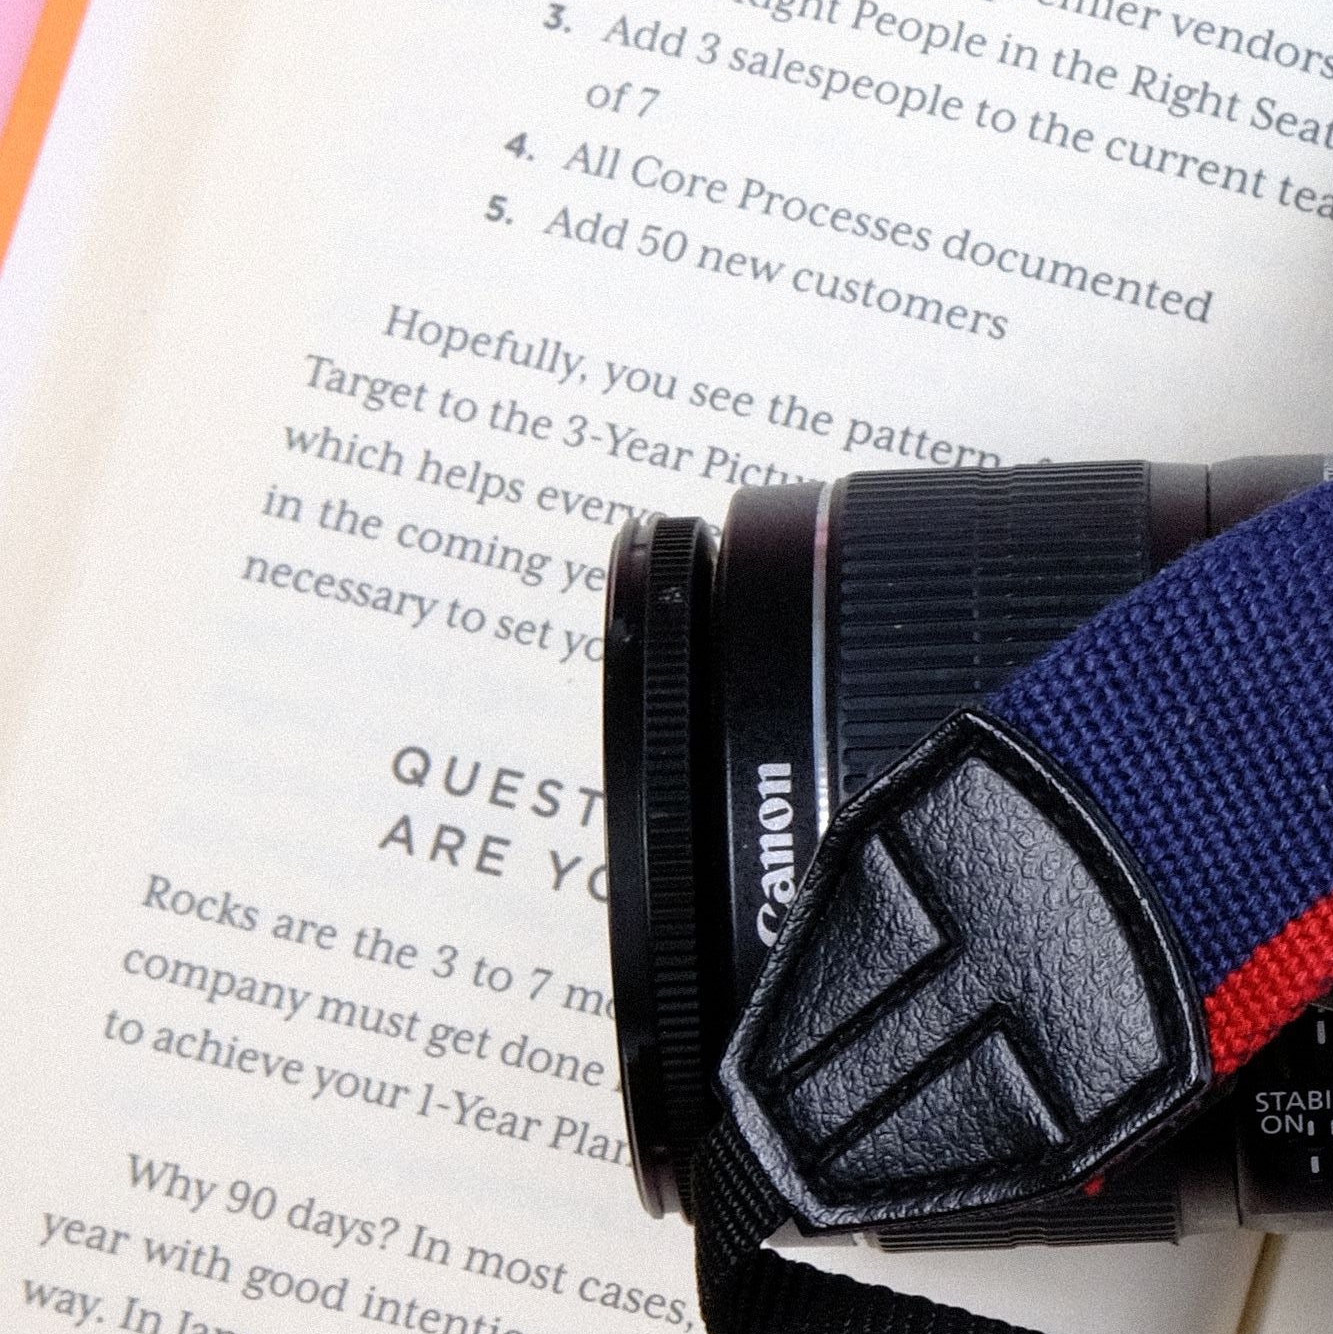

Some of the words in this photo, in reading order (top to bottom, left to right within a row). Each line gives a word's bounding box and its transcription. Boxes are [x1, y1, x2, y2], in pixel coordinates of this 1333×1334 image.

[585, 81, 633, 113] of
[637, 86, 661, 118] 7
[997, 33, 1039, 72] in
[1051, 48, 1119, 91] the
[1127, 64, 1241, 123] Right
[483, 193, 514, 226] 5.
[542, 206, 630, 251] Add
[637, 224, 689, 263] 50
[695, 244, 786, 284] new
[791, 267, 1009, 341] customers
[503, 131, 535, 162] 4.
[562, 142, 622, 180] All
[630, 154, 728, 204] Core
[737, 177, 933, 252] Processes
[941, 228, 1215, 324] documented
[305, 353, 428, 413] Target
[438, 388, 479, 423] to
[488, 399, 554, 441] the
[562, 414, 695, 472] 3-Year
[383, 303, 587, 385] Hopefully,
[602, 360, 678, 401] you
[688, 381, 755, 418] see
[767, 394, 834, 437] the
[377, 813, 513, 878] ARE
[757, 763, 797, 948] Canon
[141, 873, 260, 932] Rocks
[271, 913, 338, 951] are
[352, 927, 419, 971] the
[431, 944, 459, 979] 3
[472, 956, 514, 993] to
[529, 966, 554, 1001] 7
[1261, 1113, 1304, 1134] ON
[39, 1212, 132, 1256] year
[143, 1237, 232, 1284] with
[241, 1265, 350, 1312] good
[128, 1152, 219, 1214] Why
[225, 1179, 278, 1221] 90
[286, 1196, 401, 1251] days?
[406, 1224, 452, 1266] In
[462, 1246, 568, 1295] most
[577, 1276, 704, 1333] cases,
[22, 1279, 104, 1328] way.
